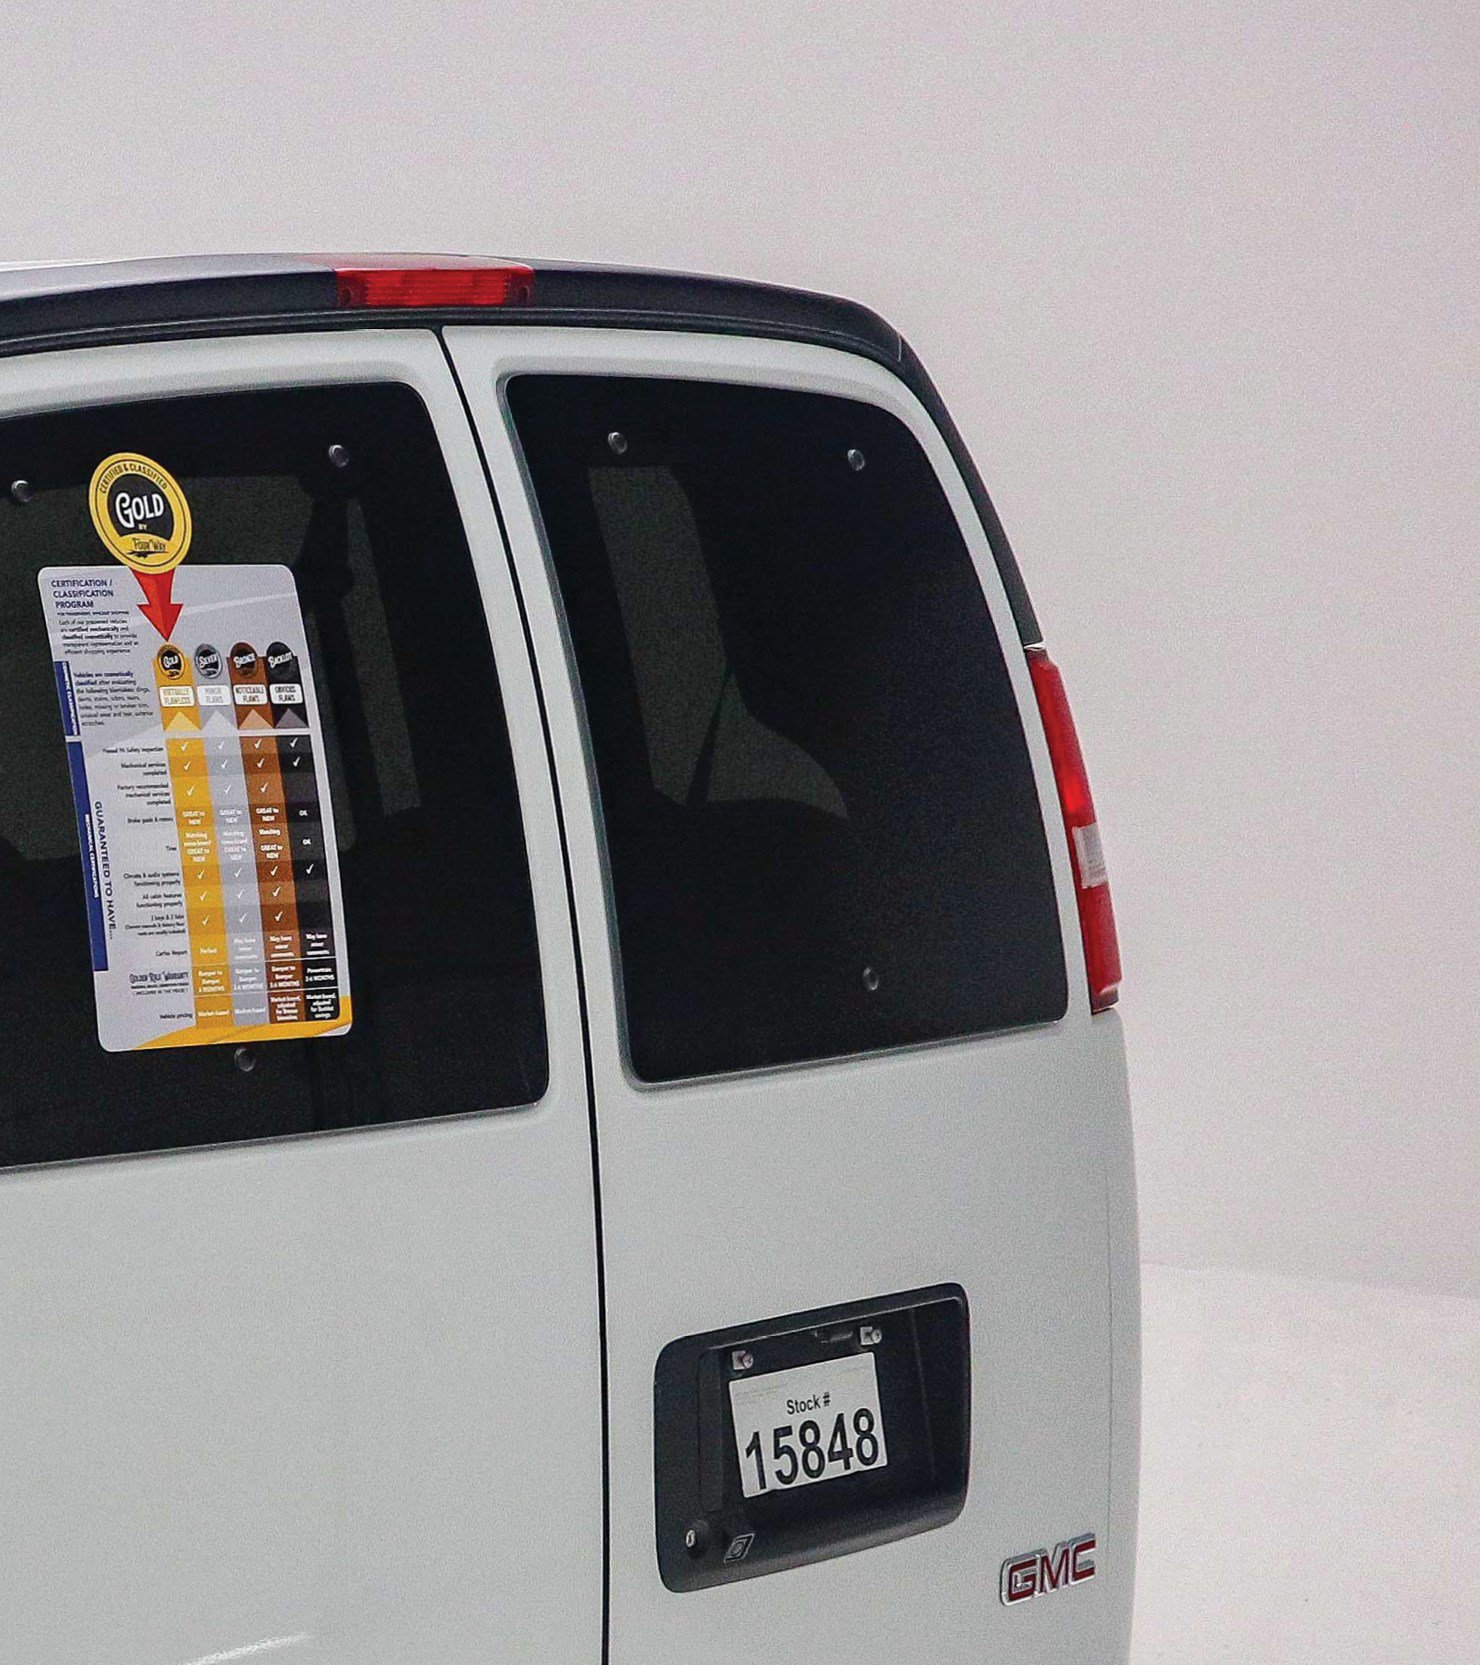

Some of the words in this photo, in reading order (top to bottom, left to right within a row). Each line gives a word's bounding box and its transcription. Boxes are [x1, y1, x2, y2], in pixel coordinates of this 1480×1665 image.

[99, 464, 123, 494] CERTIFIED
[123, 464, 129, 472] &
[129, 463, 168, 490] CLASSIFIED
[115, 492, 165, 528] GOLD
[132, 538, 150, 550] FOUR
[149, 539, 166, 551] WAY
[51, 579, 107, 587] CERTIFICATION
[53, 590, 114, 598] CLASSIFICATION
[55, 600, 94, 609] PROGRAM
[163, 655, 179, 669] GOLD
[198, 653, 218, 669] SILVER
[235, 686, 264, 694] NOTICEABLE
[278, 693, 296, 702] FLAWS
[242, 694, 260, 703] FLAWS
[66, 691, 78, 736] CLASSIFICATION
[94, 802, 110, 878] GUARANTEED
[104, 881, 112, 896] TO
[787, 1395, 821, 1415] Stock
[823, 1392, 831, 1407] #
[745, 1408, 879, 1490] 15848
[1000, 1532, 1096, 1606] GMC
